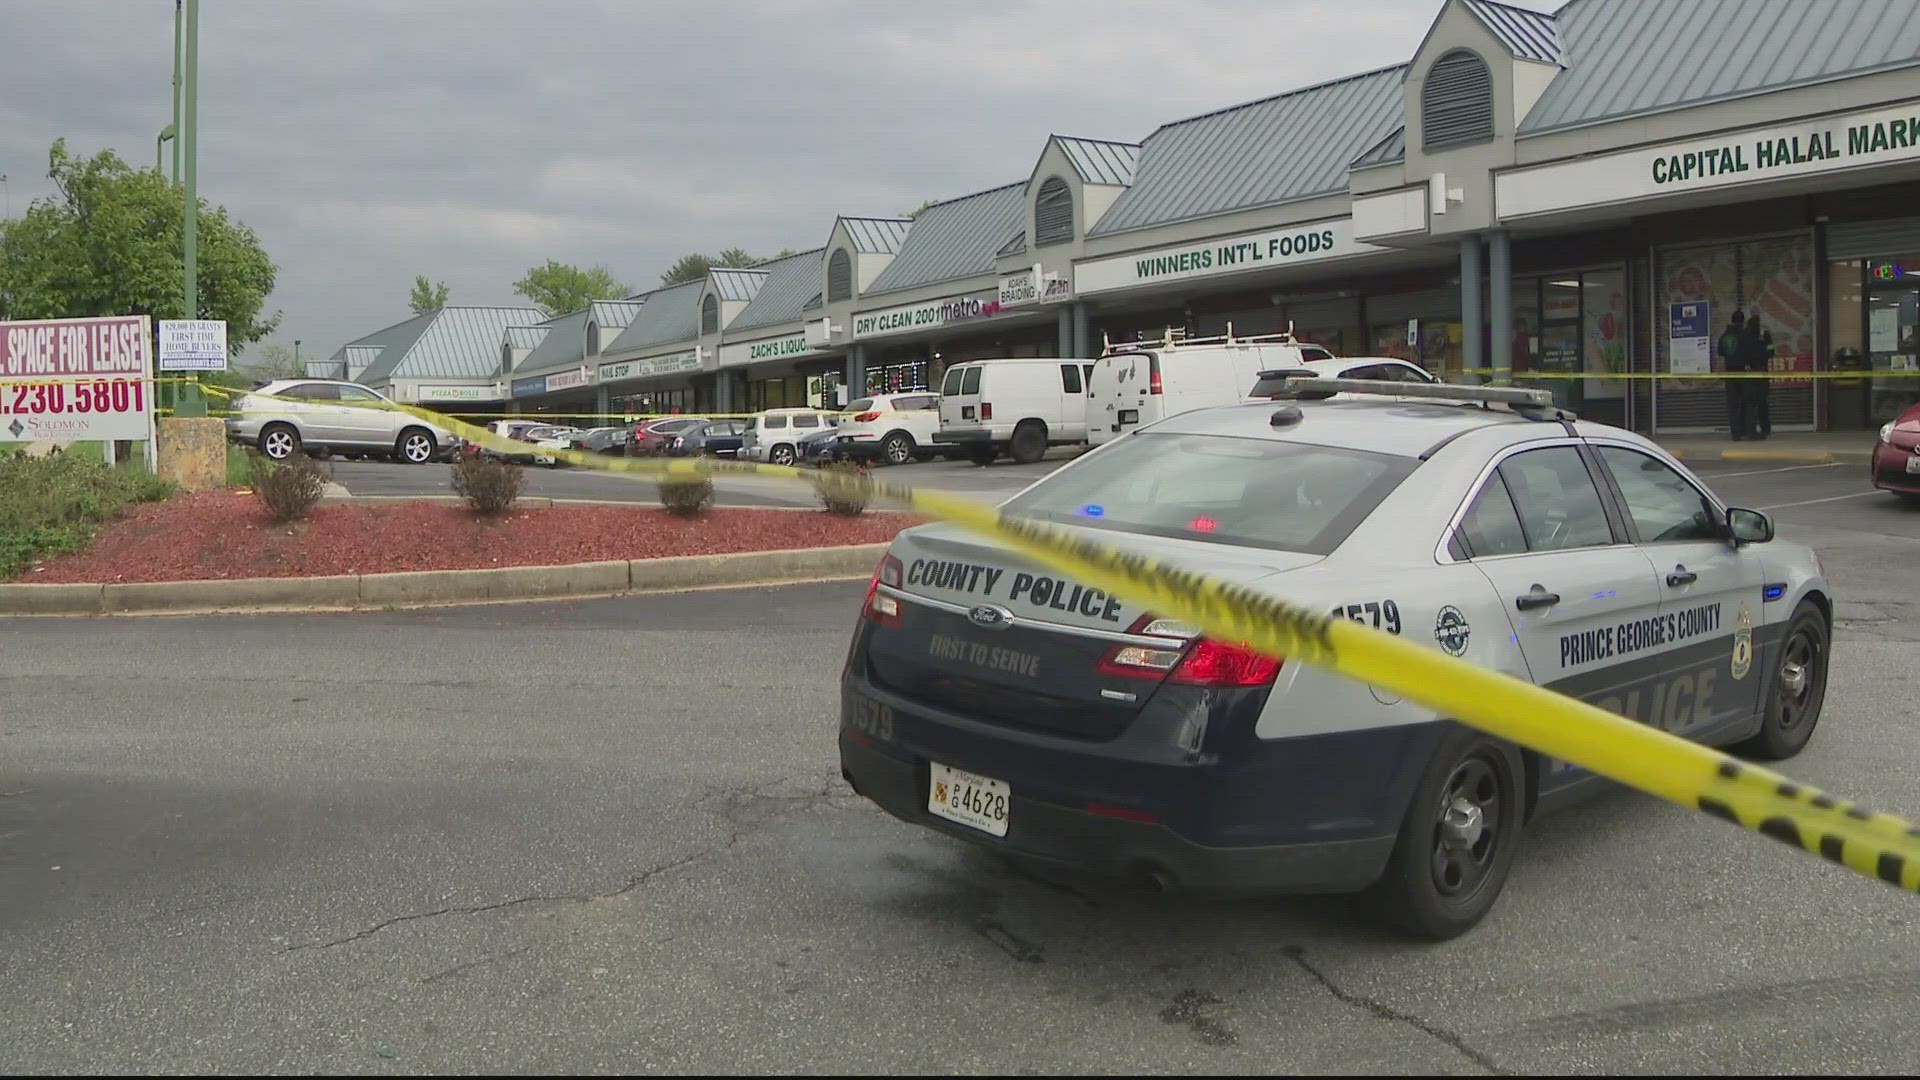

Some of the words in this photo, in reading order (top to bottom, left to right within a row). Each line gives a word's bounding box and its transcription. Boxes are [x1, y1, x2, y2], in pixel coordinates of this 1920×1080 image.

[1652, 145, 1749, 184] CAPITAL
[1756, 131, 1840, 169] HALAL
[1136, 249, 1212, 278] WINNERS
[1217, 241, 1263, 266] INT'L
[1268, 230, 1334, 258] FOODS
[1001, 286, 1035, 303] BRAIDING
[856, 317, 877, 334] DRY
[878, 312, 912, 331] CLEAN
[914, 306, 940, 325] 2001
[940, 298, 980, 321] metro
[166, 342, 187, 351] HOME
[191, 342, 221, 351] BUYERS
[171, 332, 193, 341] FIRST
[198, 332, 215, 341] TIME
[751, 341, 779, 359] ZACH'S
[780, 337, 814, 355] LIQUO
[8, 327, 55, 374] SPACE
[58, 325, 89, 373] FOR
[92, 323, 141, 372] LEASE
[601, 366, 614, 378] NAIL
[615, 364, 629, 378] STOP
[431, 389, 451, 397] PIZZA
[28, 417, 90, 430] SOLOMON
[907, 558, 1003, 596] COUNTY
[1009, 572, 1122, 623] POLICE
[973, 607, 997, 623] Ford
[1560, 626, 1613, 669] PRINCE
[1617, 613, 1676, 656] GEORGE'S
[1677, 602, 1721, 641] COUNTY
[930, 634, 967, 662] FIRST
[970, 645, 987, 665] TO
[988, 648, 1041, 678] SERVE
[962, 785, 1005, 821] 4628
